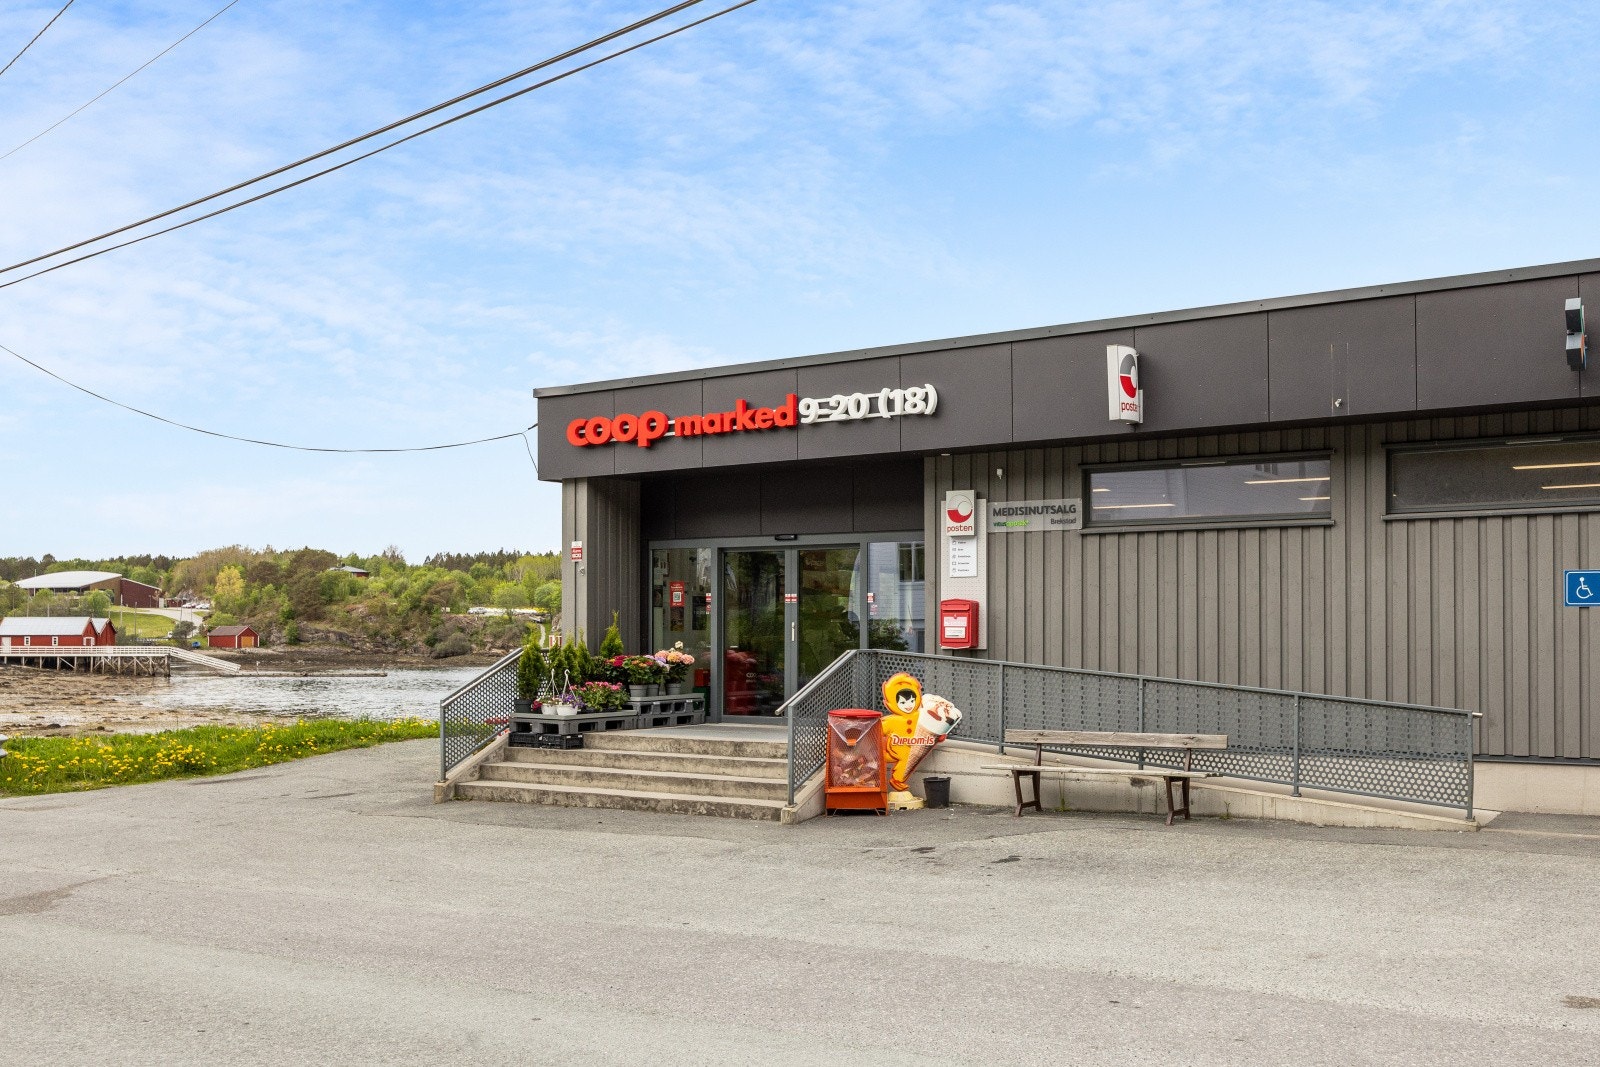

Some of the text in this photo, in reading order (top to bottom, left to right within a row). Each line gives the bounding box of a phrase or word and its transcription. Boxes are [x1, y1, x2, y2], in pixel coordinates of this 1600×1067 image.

[567, 383, 938, 447] coop marked 9-20 (18)
[992, 504, 1077, 517] MEDISINUTSALG
[946, 524, 973, 534] posten
